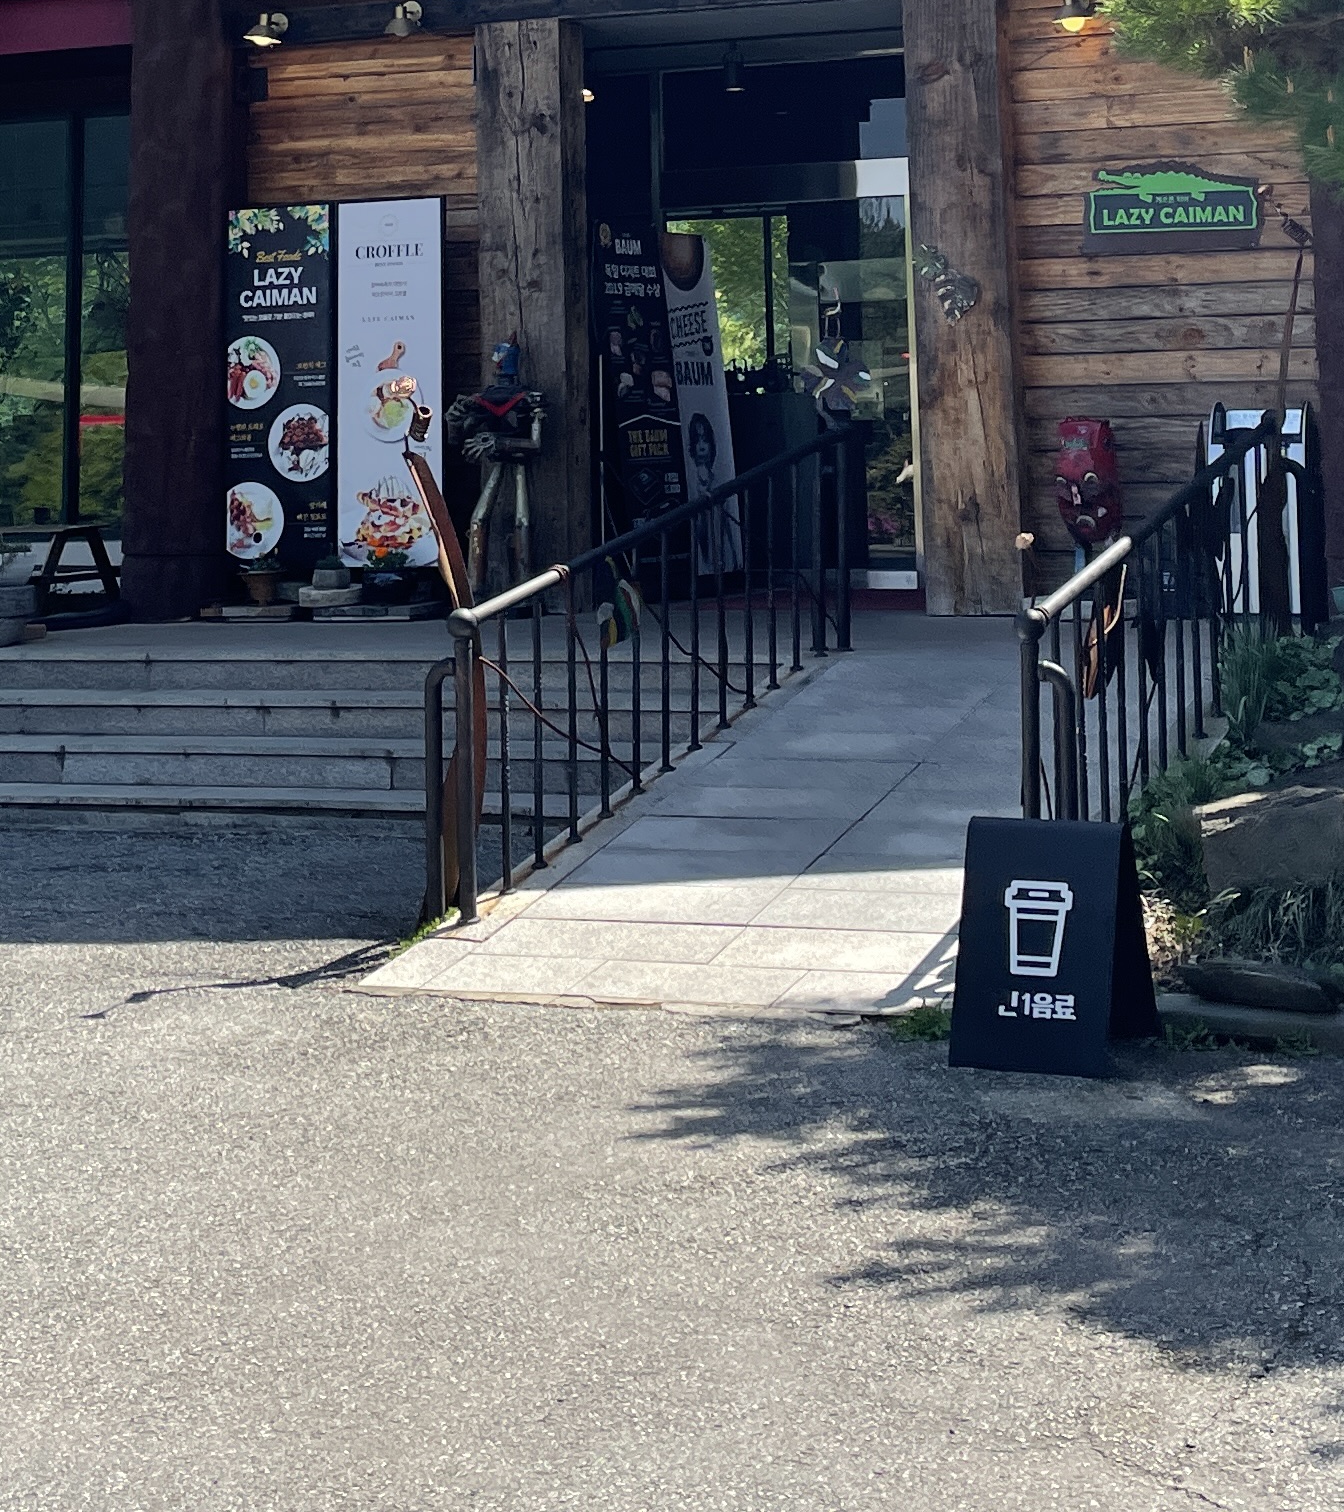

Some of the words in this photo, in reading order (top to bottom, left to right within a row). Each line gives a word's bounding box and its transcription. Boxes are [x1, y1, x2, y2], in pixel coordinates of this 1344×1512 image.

[1103, 208, 1154, 226] LAZY
[1159, 205, 1244, 225] CAIMAN
[355, 242, 424, 260] CROFFLE
[615, 238, 643, 256] BAUM
[253, 267, 303, 286] LAZY
[239, 286, 317, 308] CAIMAN
[670, 310, 708, 339] CHEESE
[675, 361, 714, 386] BAUM
